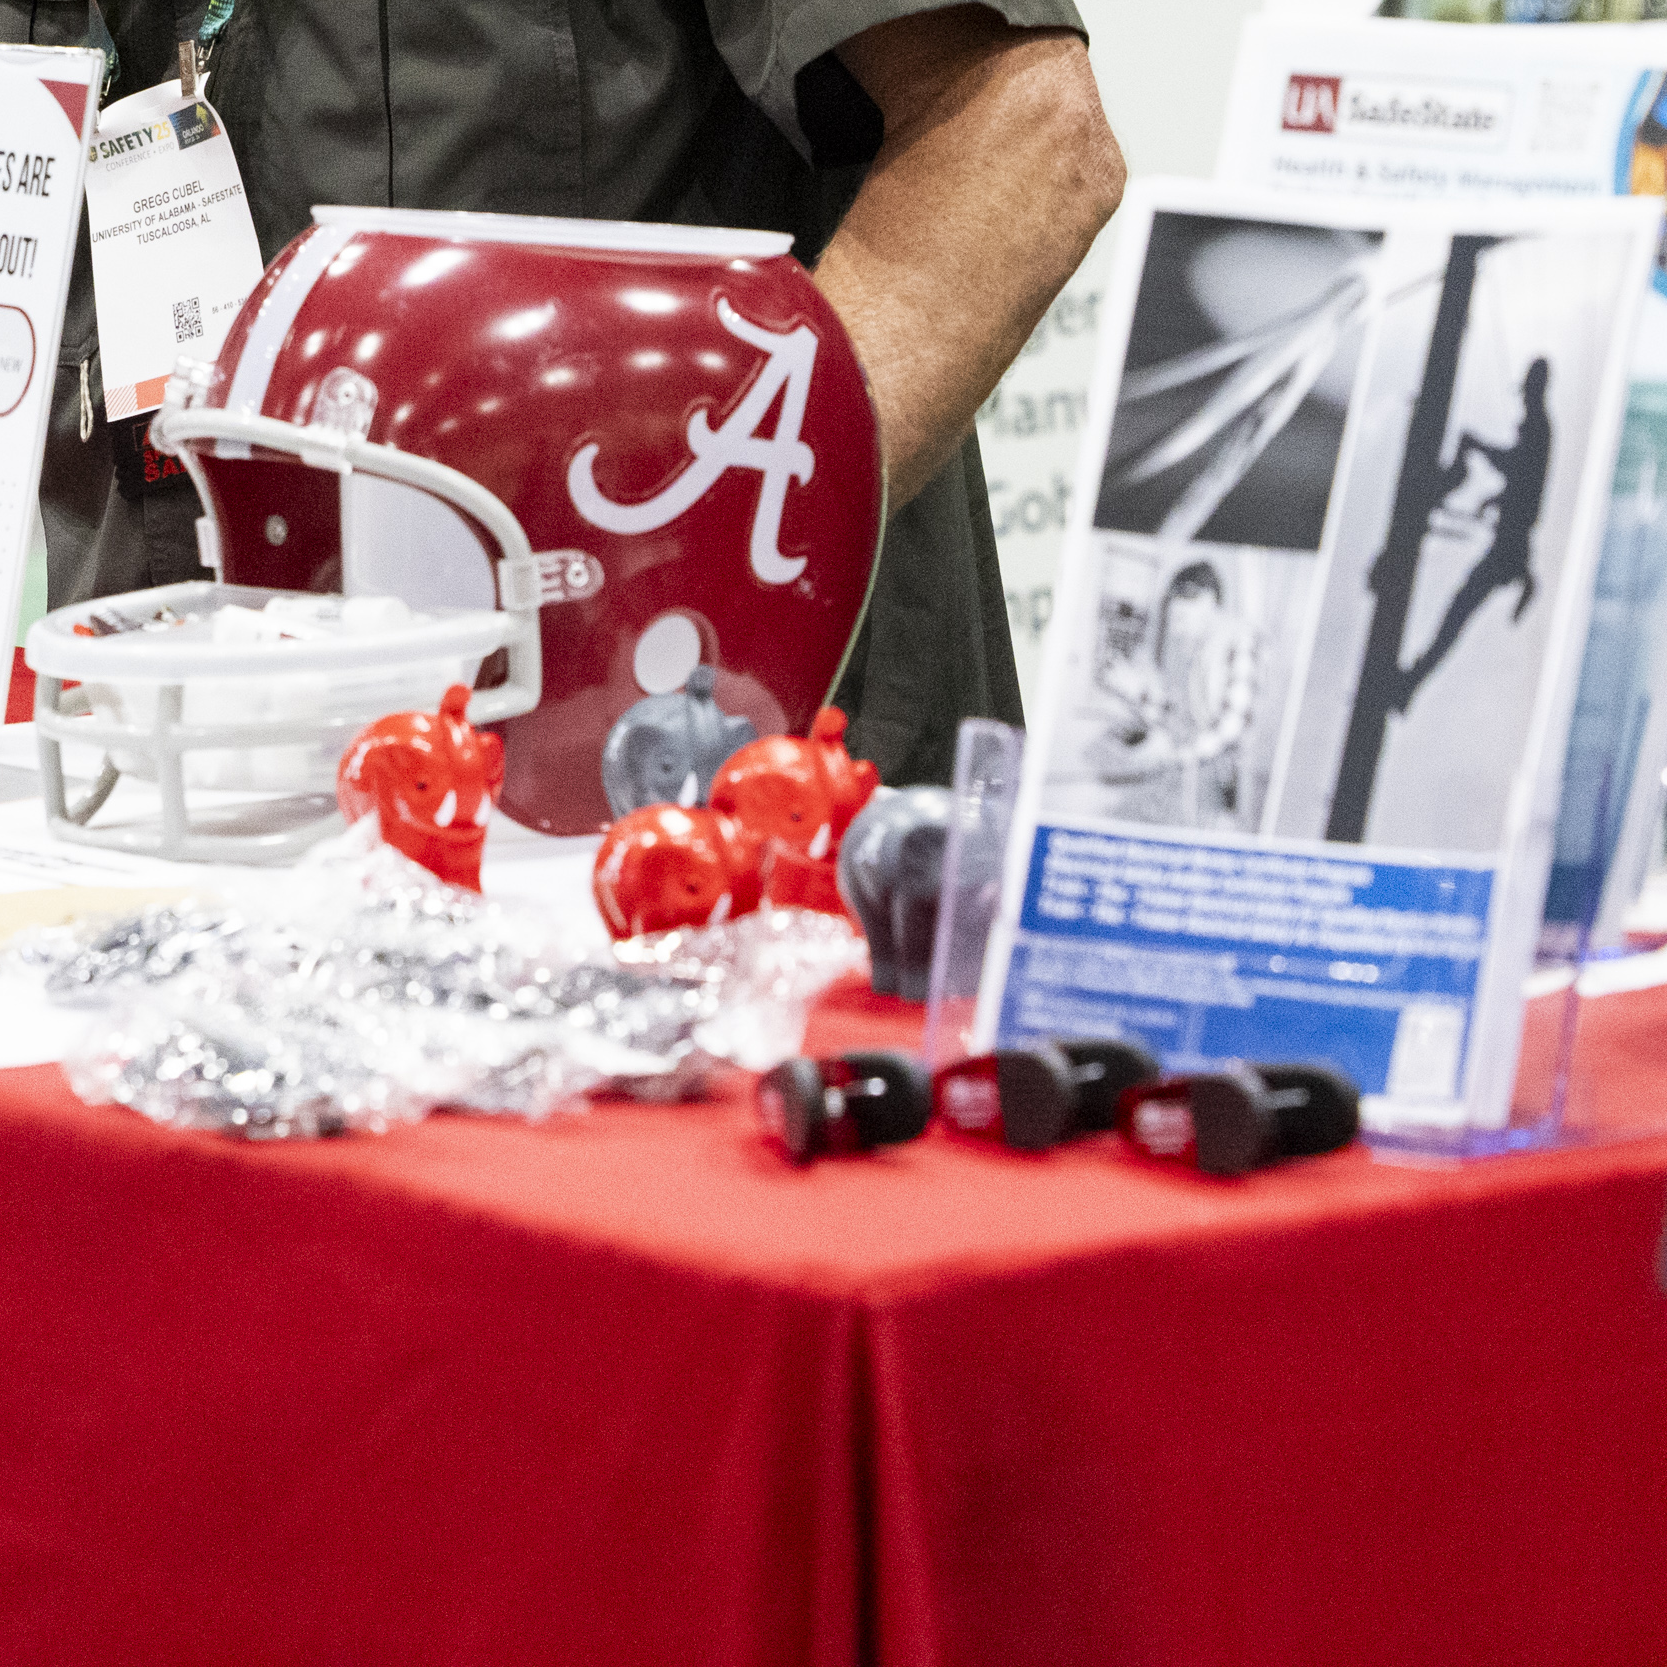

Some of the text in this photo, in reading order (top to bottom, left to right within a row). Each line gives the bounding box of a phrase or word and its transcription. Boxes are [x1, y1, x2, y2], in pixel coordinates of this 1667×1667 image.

[1350, 93, 1497, 131] SafeState
[99, 121, 171, 159] SAFETY25
[105, 141, 175, 172] CONFERENCE EXPO
[16, 153, 56, 197] ARE
[91, 183, 243, 244] UNIVERSITY OF ALABAMA SAFESTATE
[133, 179, 205, 214] GREGG CUBEL
[136, 212, 212, 246] TUSCALOOSA, AL
